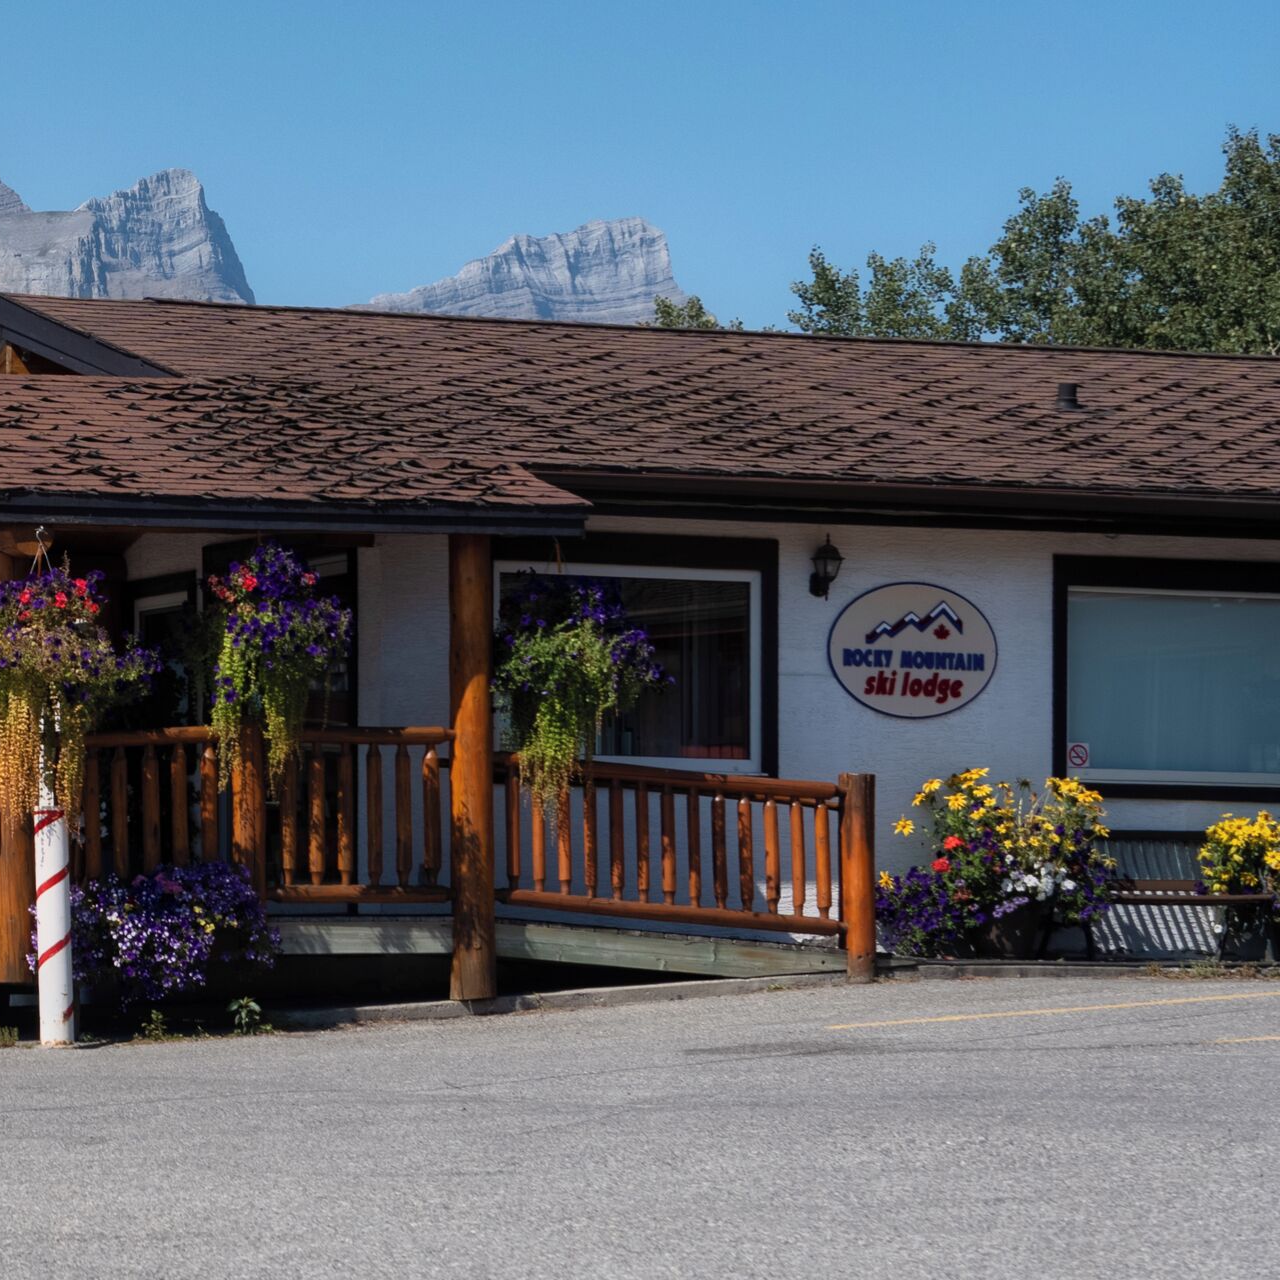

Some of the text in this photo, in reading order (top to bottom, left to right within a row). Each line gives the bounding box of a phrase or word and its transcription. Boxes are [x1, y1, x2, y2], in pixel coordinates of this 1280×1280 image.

[843, 648, 985, 671] ROCKY MOUNTAIN
[864, 670, 964, 704] ski lodge
